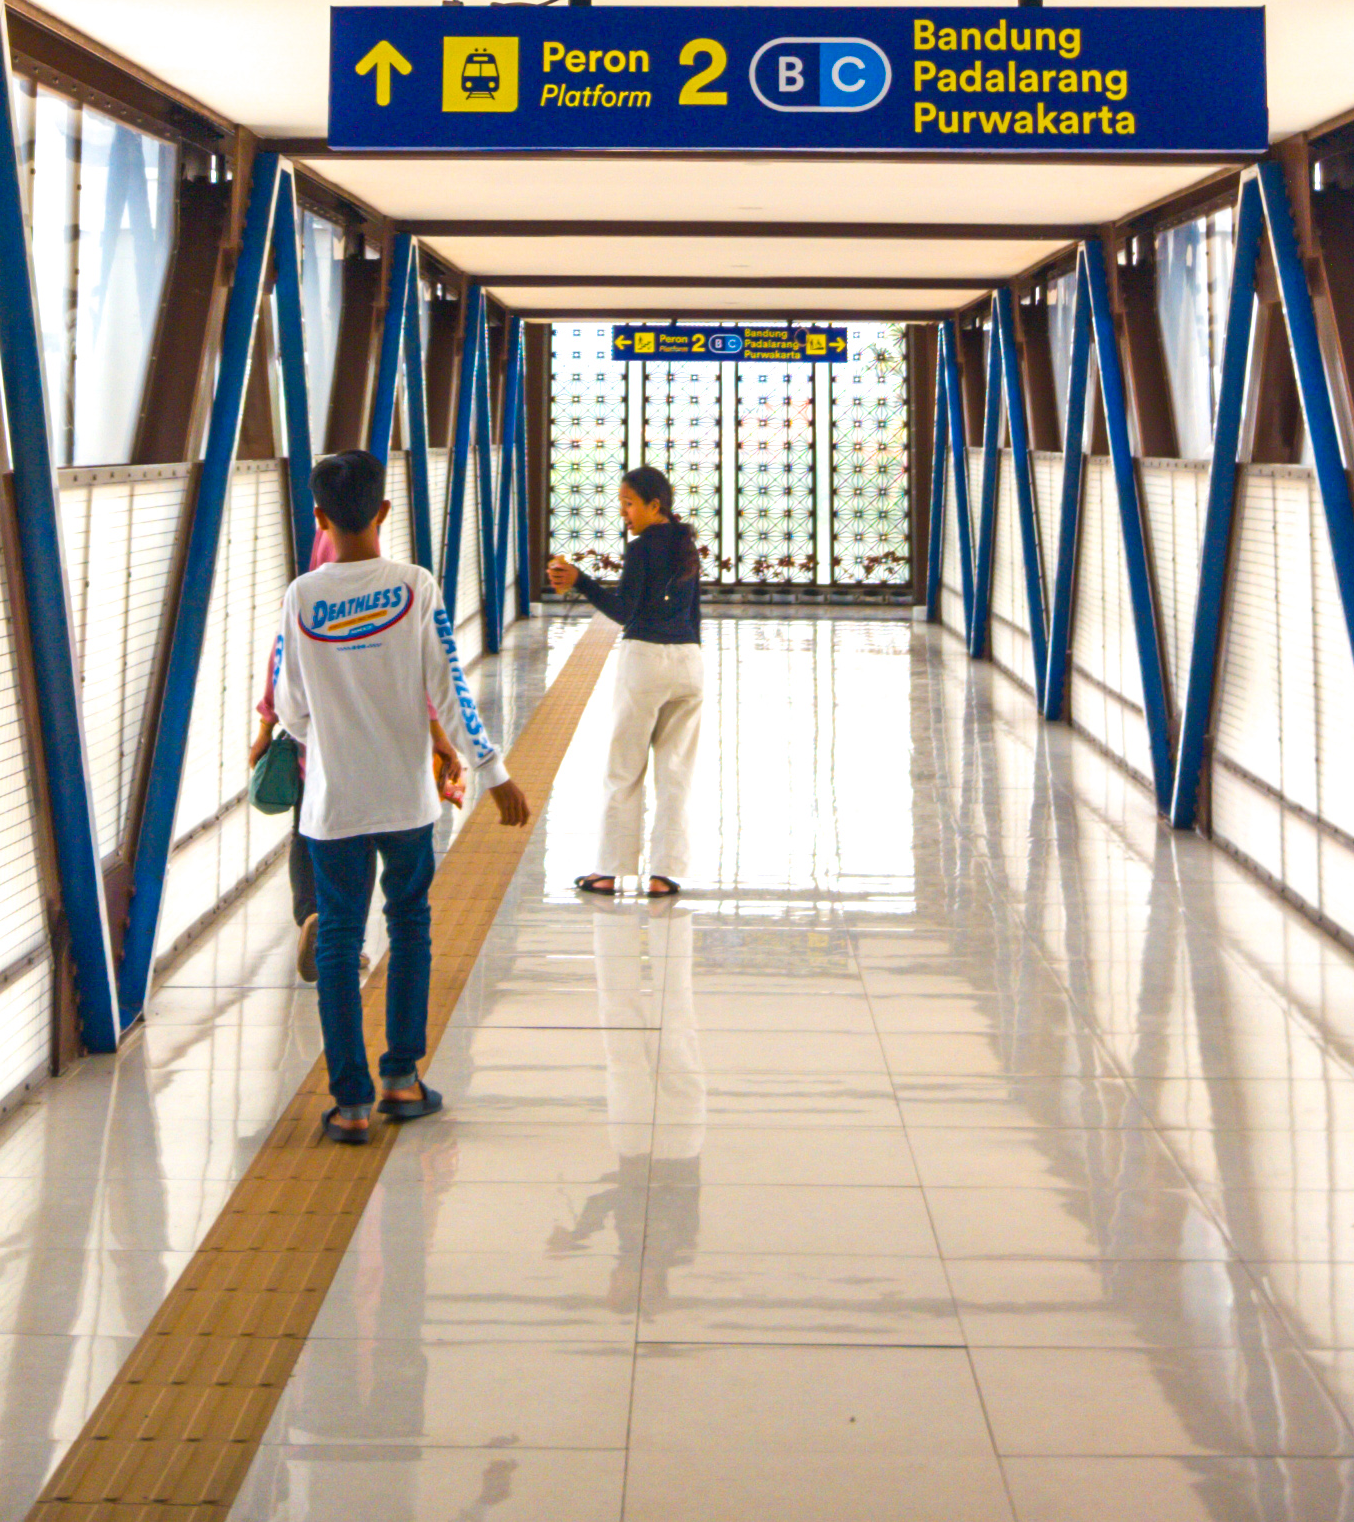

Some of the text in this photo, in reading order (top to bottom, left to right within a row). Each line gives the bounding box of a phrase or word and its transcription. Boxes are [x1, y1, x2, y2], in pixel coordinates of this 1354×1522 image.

[913, 19, 1082, 60] Bandung
[541, 41, 650, 74] Peron
[678, 37, 728, 106] 2
[777, 54, 867, 94] B C
[913, 60, 1129, 101] Padalarang
[540, 82, 653, 110] Platform
[913, 101, 1137, 135] Purwakarta
[659, 334, 688, 344] Peron
[691, 333, 706, 352] 2
[714, 338, 737, 348] B C
[744, 328, 788, 339] Bandung
[744, 339, 799, 350] Padalarang
[744, 350, 801, 359] Purwakarta
